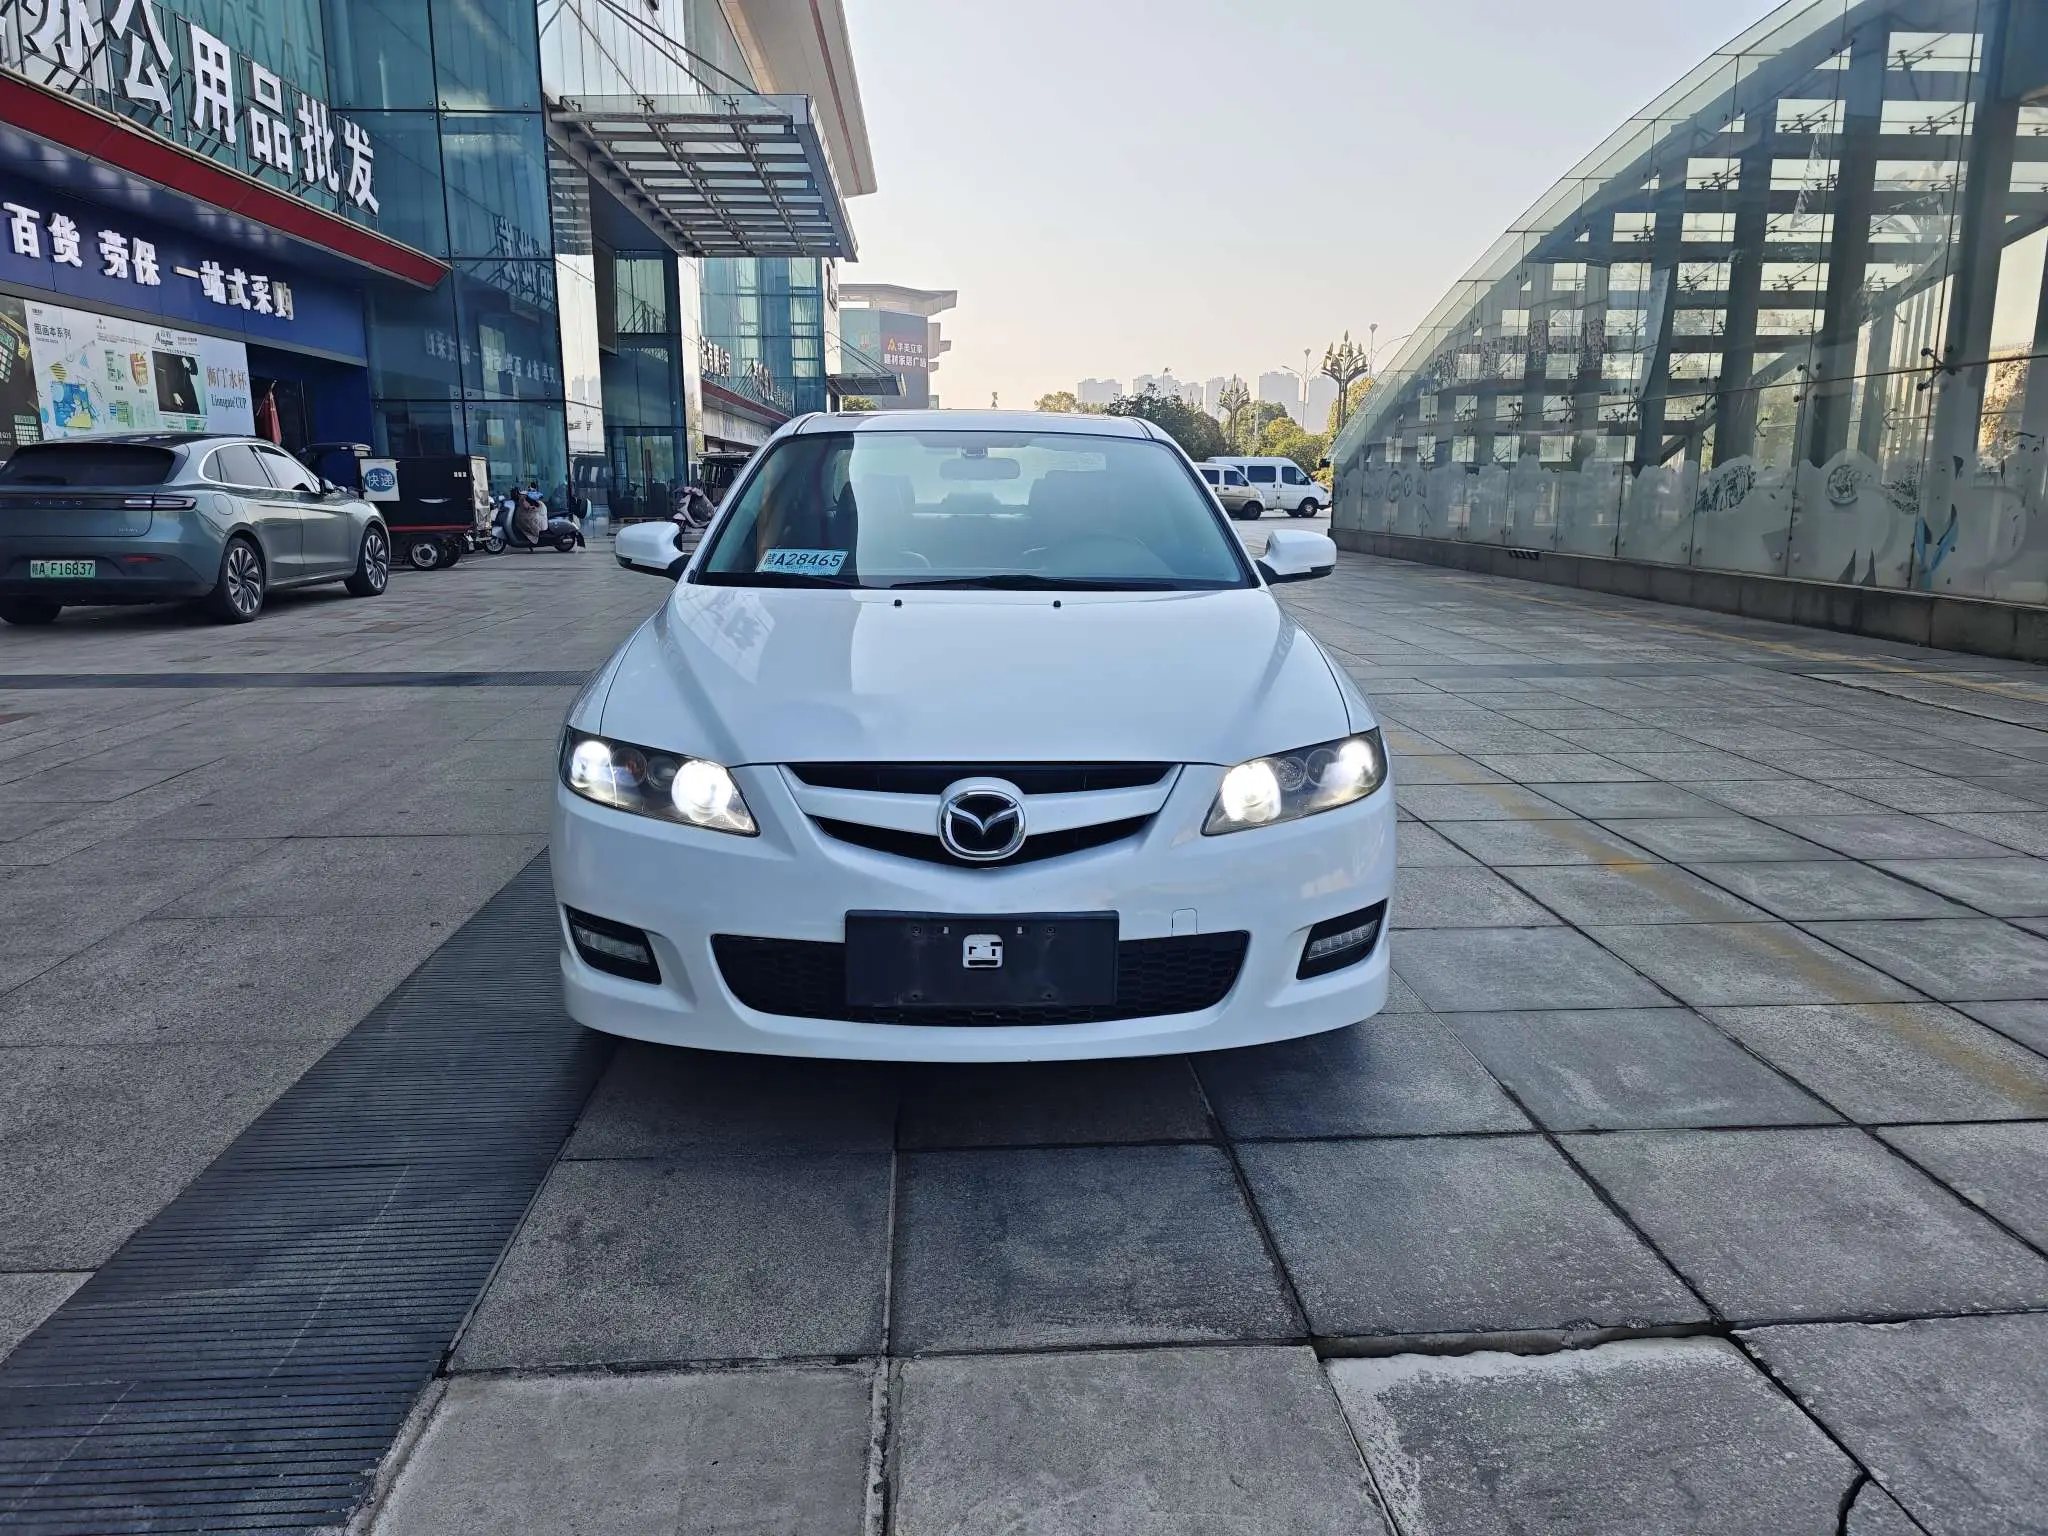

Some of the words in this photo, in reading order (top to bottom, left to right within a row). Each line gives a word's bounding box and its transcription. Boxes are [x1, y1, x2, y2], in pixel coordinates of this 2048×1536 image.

[3, 202, 83, 268] 百货
[98, 229, 161, 286] 劳保
[172, 260, 294, 321] 一站式采购
[366, 472, 394, 487] 快递
